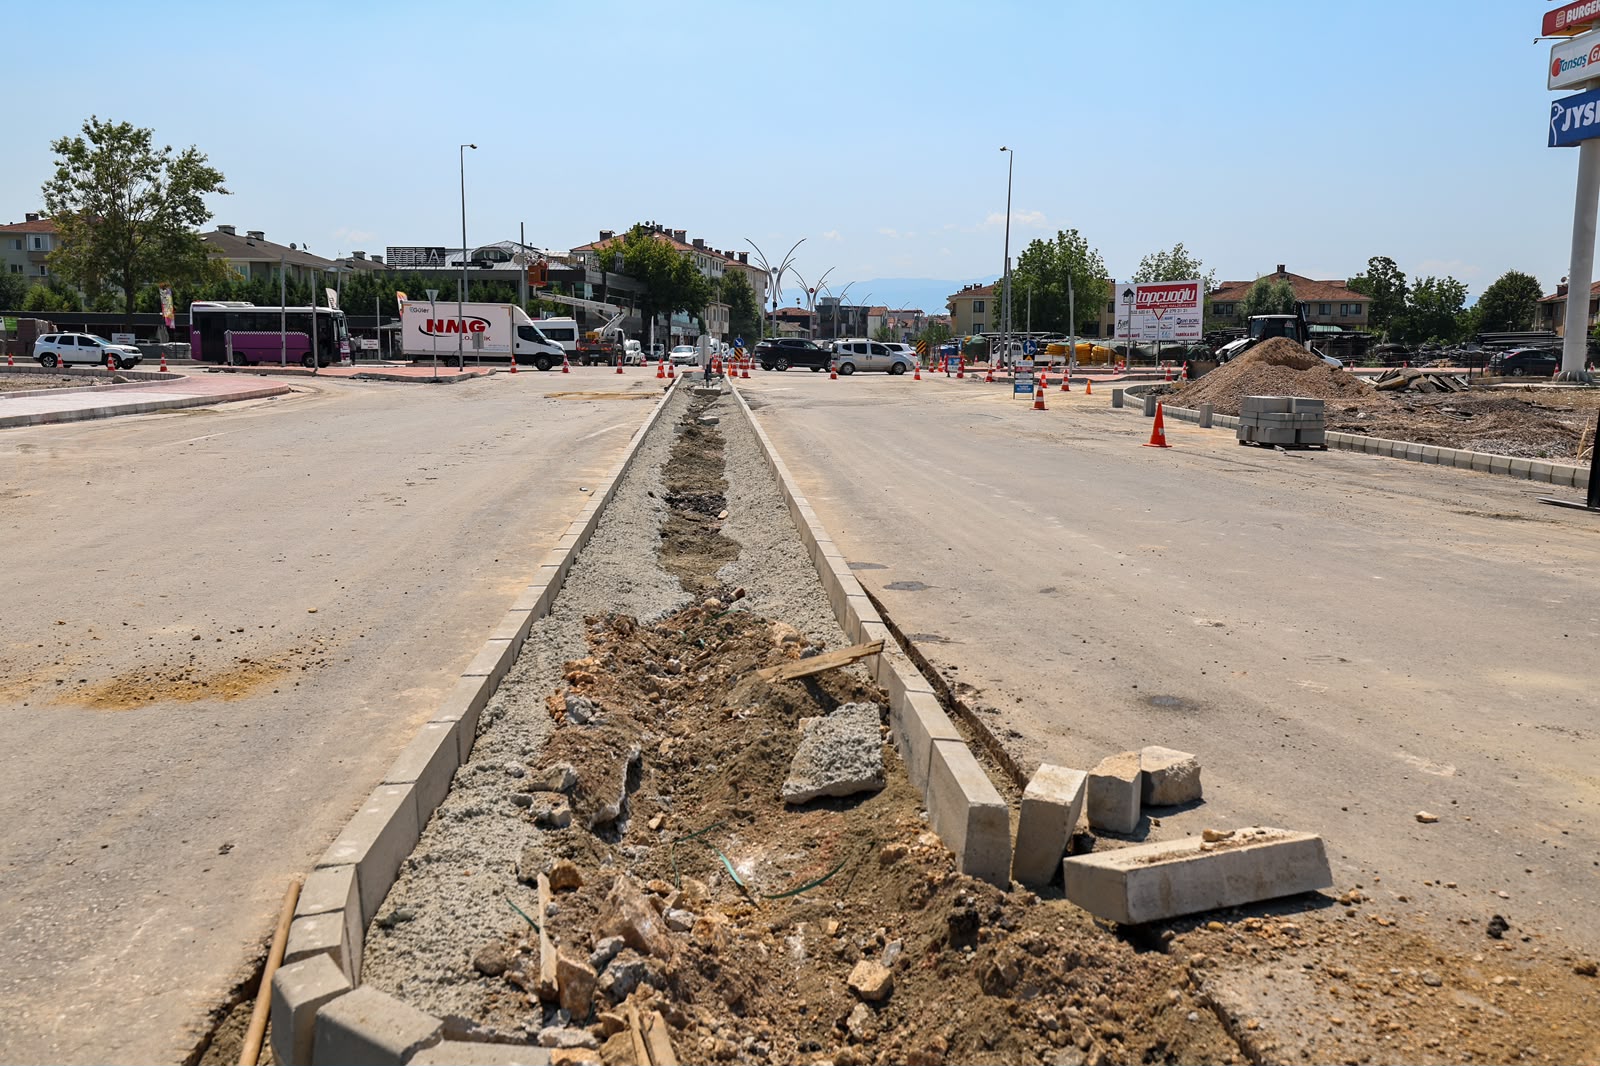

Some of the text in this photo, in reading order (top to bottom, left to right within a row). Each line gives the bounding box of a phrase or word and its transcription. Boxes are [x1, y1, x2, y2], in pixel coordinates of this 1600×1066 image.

[1559, 54, 1588, 73] Tansaş
[1138, 288, 1195, 306] topçuoğlu
[426, 319, 486, 334] NMG
